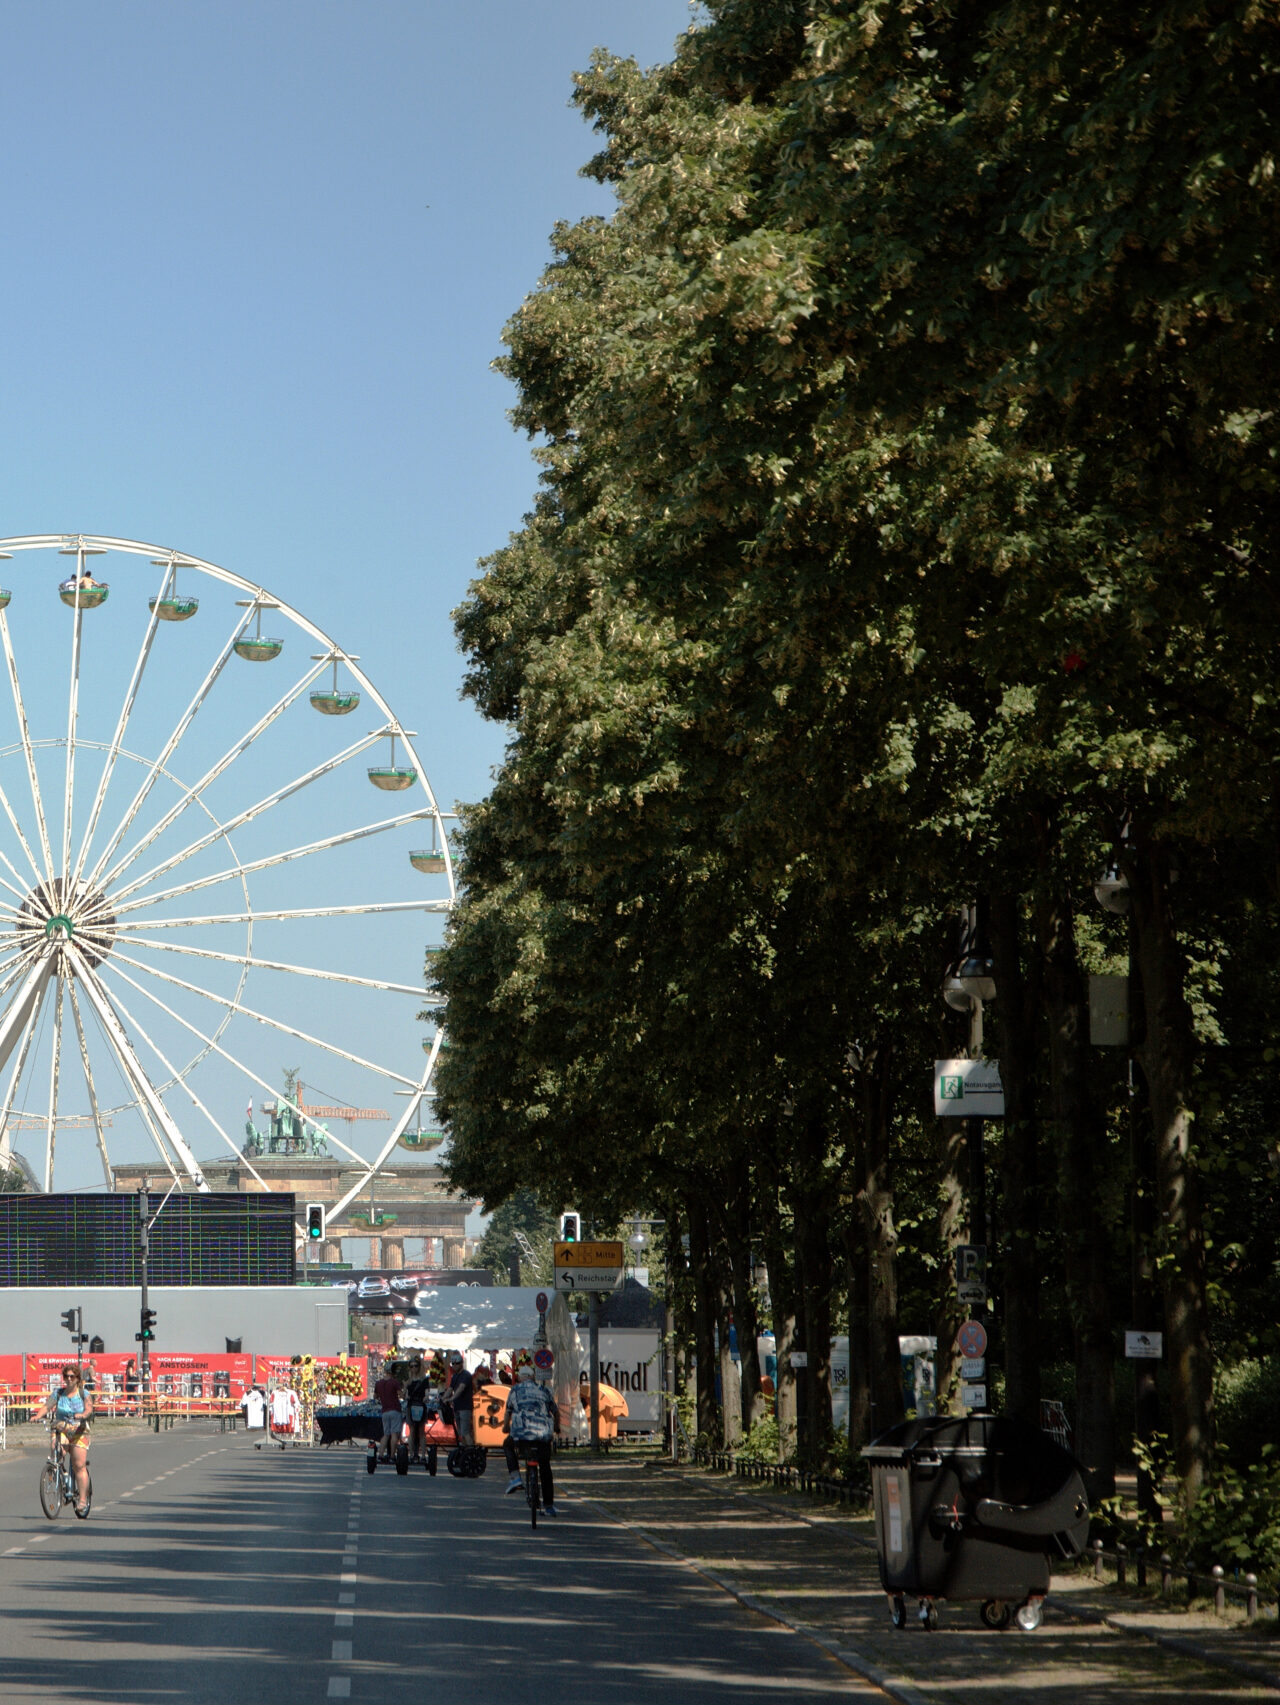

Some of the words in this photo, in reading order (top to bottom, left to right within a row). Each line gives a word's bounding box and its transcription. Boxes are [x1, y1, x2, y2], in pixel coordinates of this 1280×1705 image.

[965, 1082, 1002, 1090] Notausgan
[578, 1273, 618, 1284] Reichstag
[600, 1361, 647, 1391] Kindl
